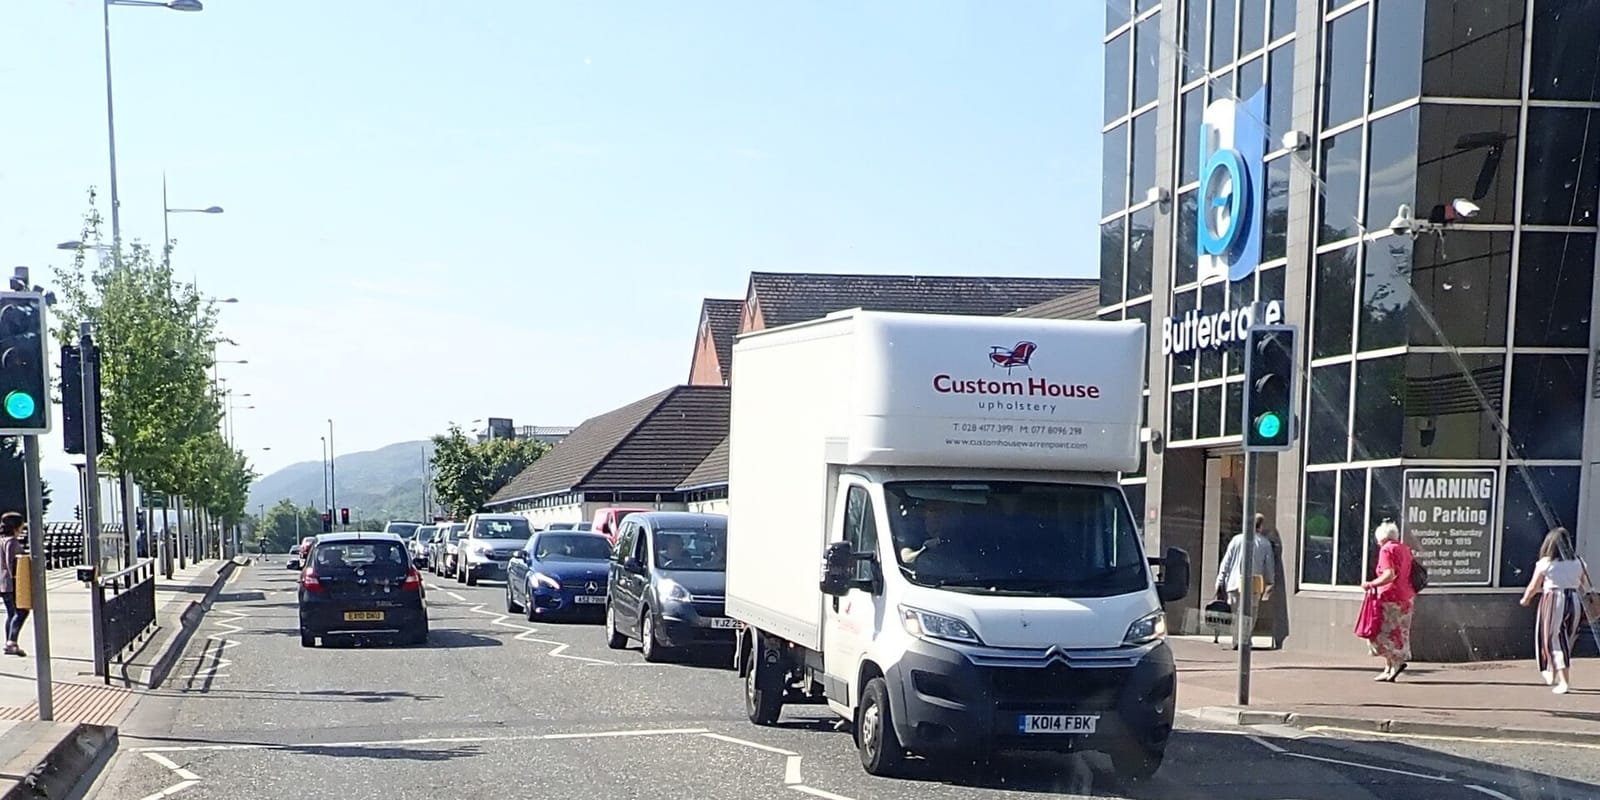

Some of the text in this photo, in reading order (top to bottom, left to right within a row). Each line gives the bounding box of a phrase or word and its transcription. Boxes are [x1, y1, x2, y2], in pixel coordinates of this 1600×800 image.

[1162, 300, 1281, 355] Buttercrae
[933, 374, 1100, 398] Custom House
[978, 401, 1056, 414] upholstery
[962, 423, 977, 432] 028
[1031, 426, 1045, 434] 077
[1408, 478, 1491, 499] WARNING
[1408, 506, 1487, 525] No Parking
[1411, 529, 1440, 538] Monday
[1449, 528, 1483, 538] Saturday
[1452, 549, 1481, 558] delivery
[1455, 558, 1469, 566] and
[1453, 567, 1480, 575] holders
[1032, 716, 1091, 730] KO14 FBK
